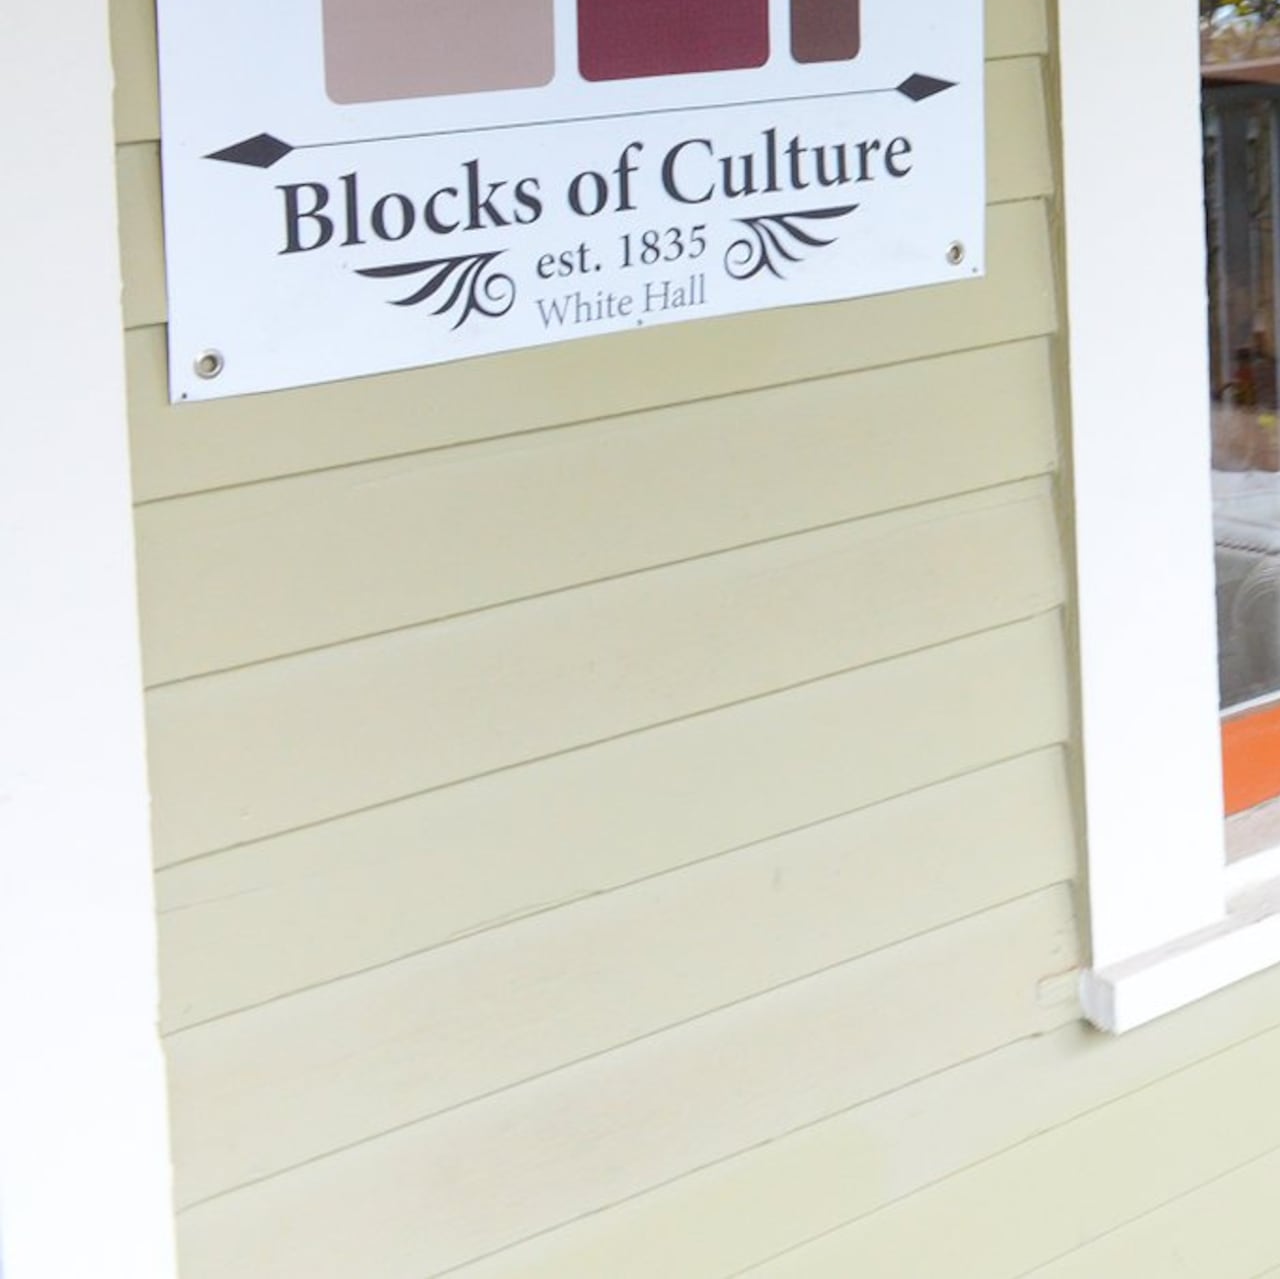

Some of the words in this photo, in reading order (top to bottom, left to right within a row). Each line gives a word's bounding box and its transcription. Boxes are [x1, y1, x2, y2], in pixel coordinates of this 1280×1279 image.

[275, 159, 543, 255] Blocks
[567, 142, 643, 217] of
[661, 127, 914, 204] Culture
[536, 243, 601, 279] est.
[622, 224, 706, 268] 1835
[535, 290, 633, 329] White
[643, 273, 705, 313] Hall
